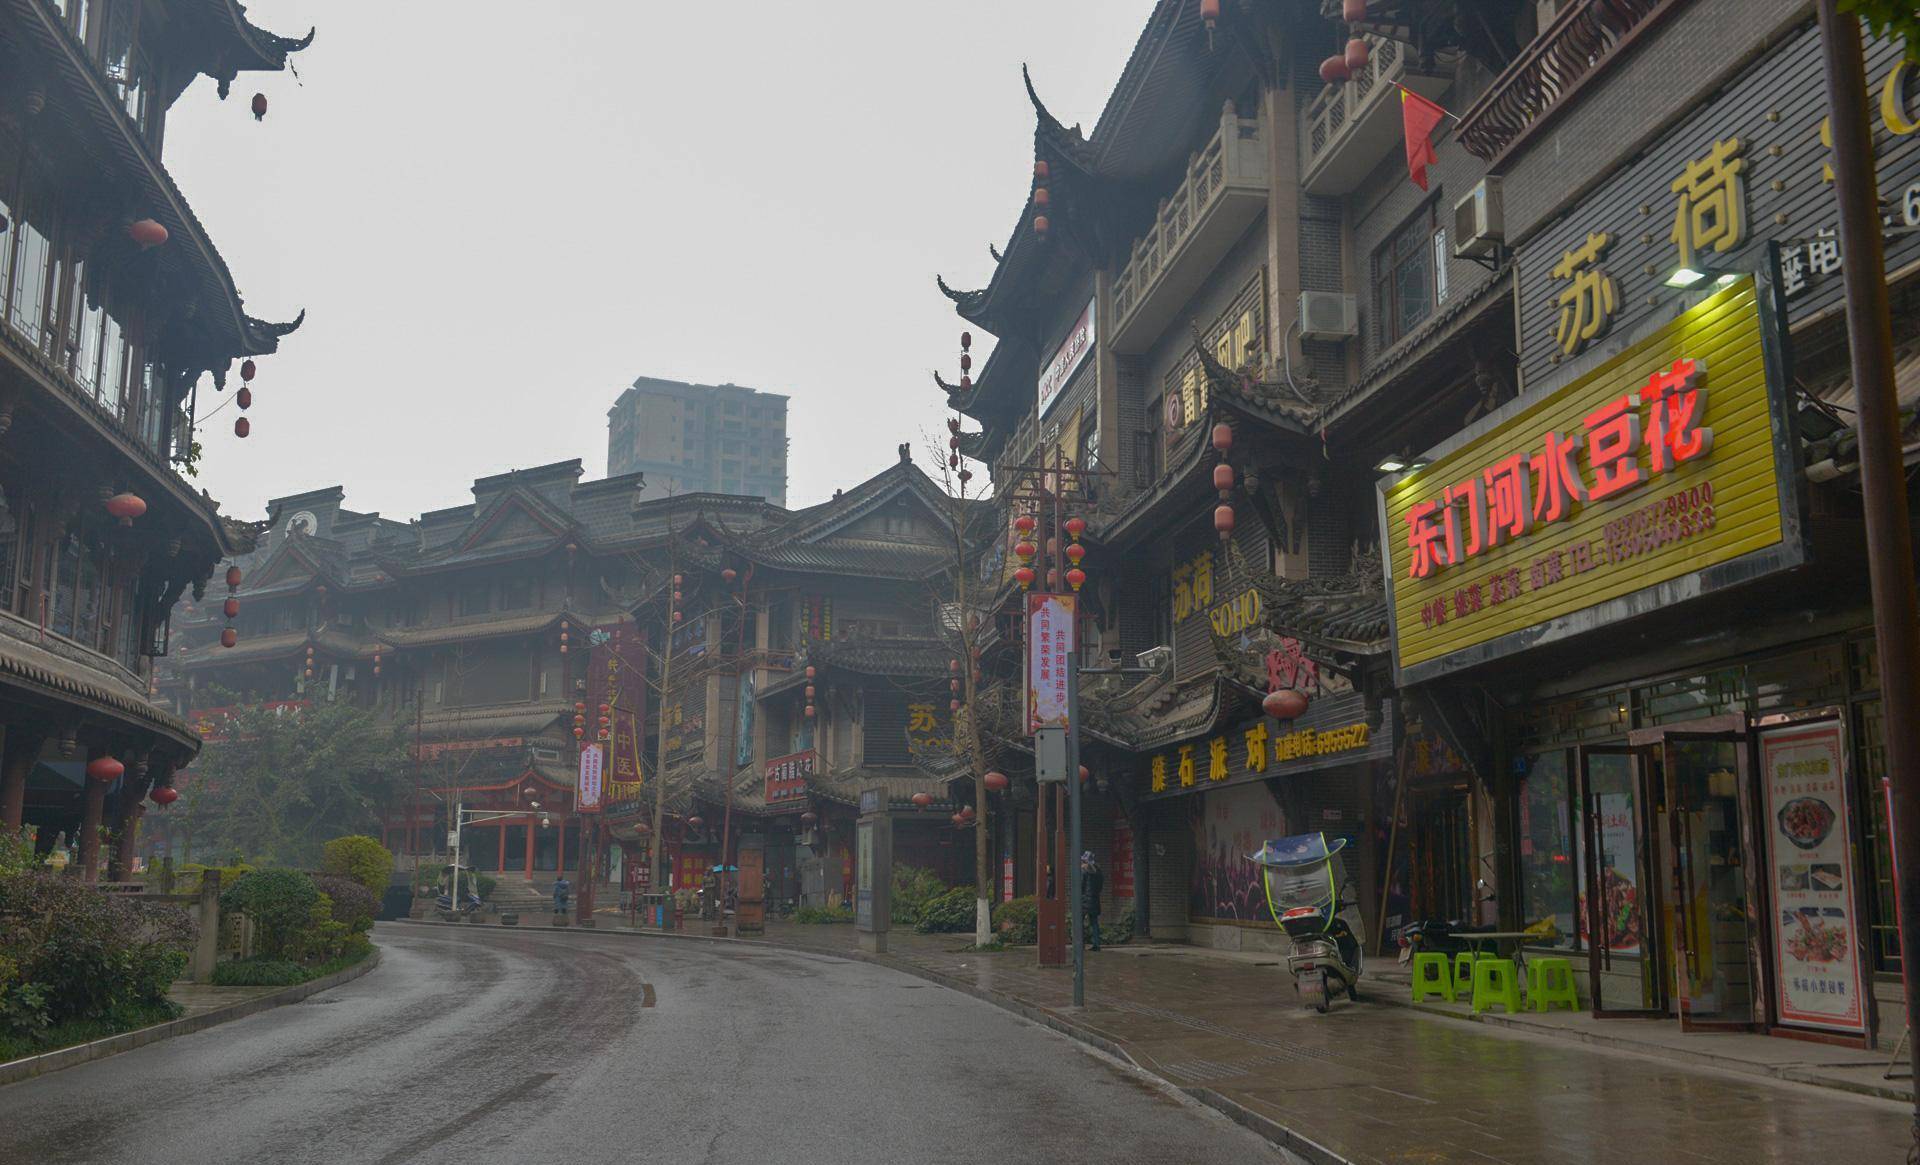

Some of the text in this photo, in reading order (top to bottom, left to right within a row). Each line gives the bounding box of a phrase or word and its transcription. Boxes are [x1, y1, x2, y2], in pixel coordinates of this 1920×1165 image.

[1554, 137, 1747, 357] 苏荷
[1405, 357, 1711, 579] 东门河水豆花
[1039, 607, 1050, 681] 共同繁荣发展
[1209, 588, 1261, 638] SOHO
[1055, 630, 1066, 704] 共同团结进步
[617, 730, 635, 776] 中医
